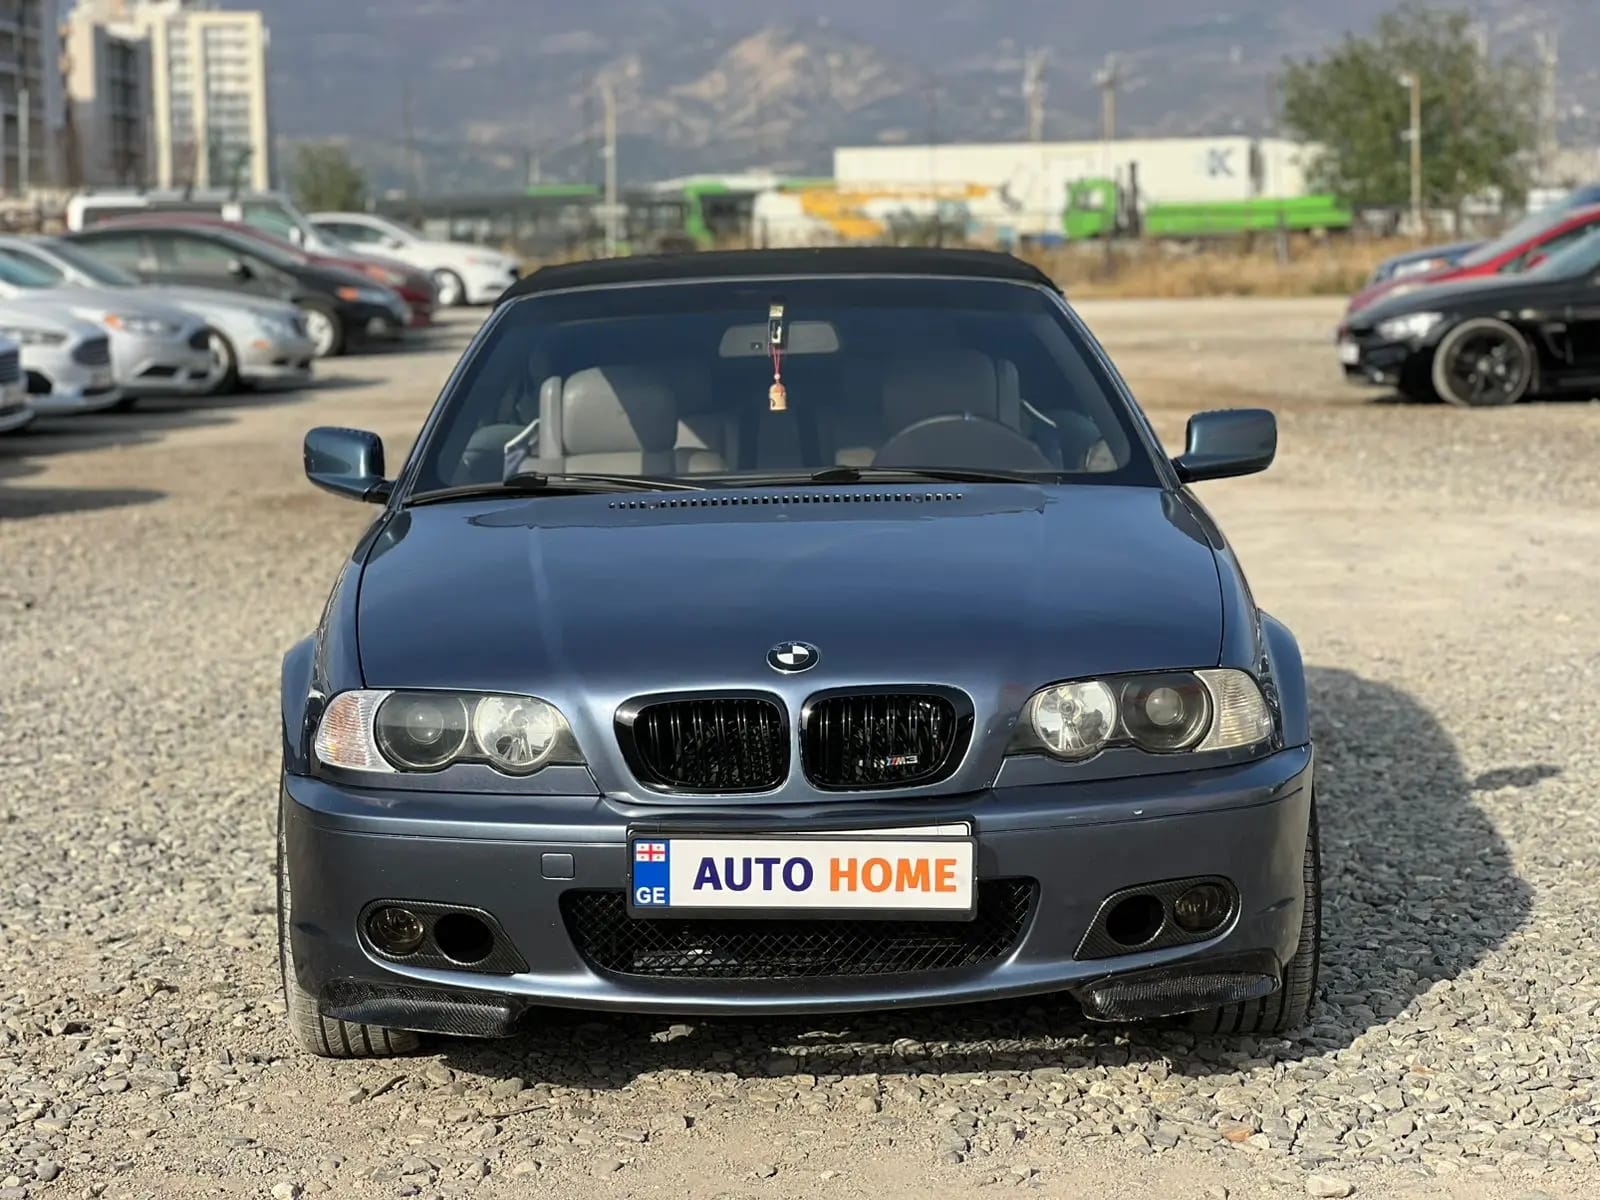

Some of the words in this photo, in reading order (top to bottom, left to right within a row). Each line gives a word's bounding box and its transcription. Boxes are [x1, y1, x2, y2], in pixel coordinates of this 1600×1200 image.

[692, 857, 814, 892] AUTO
[829, 857, 957, 893] HOME
[636, 886, 666, 904] GE
